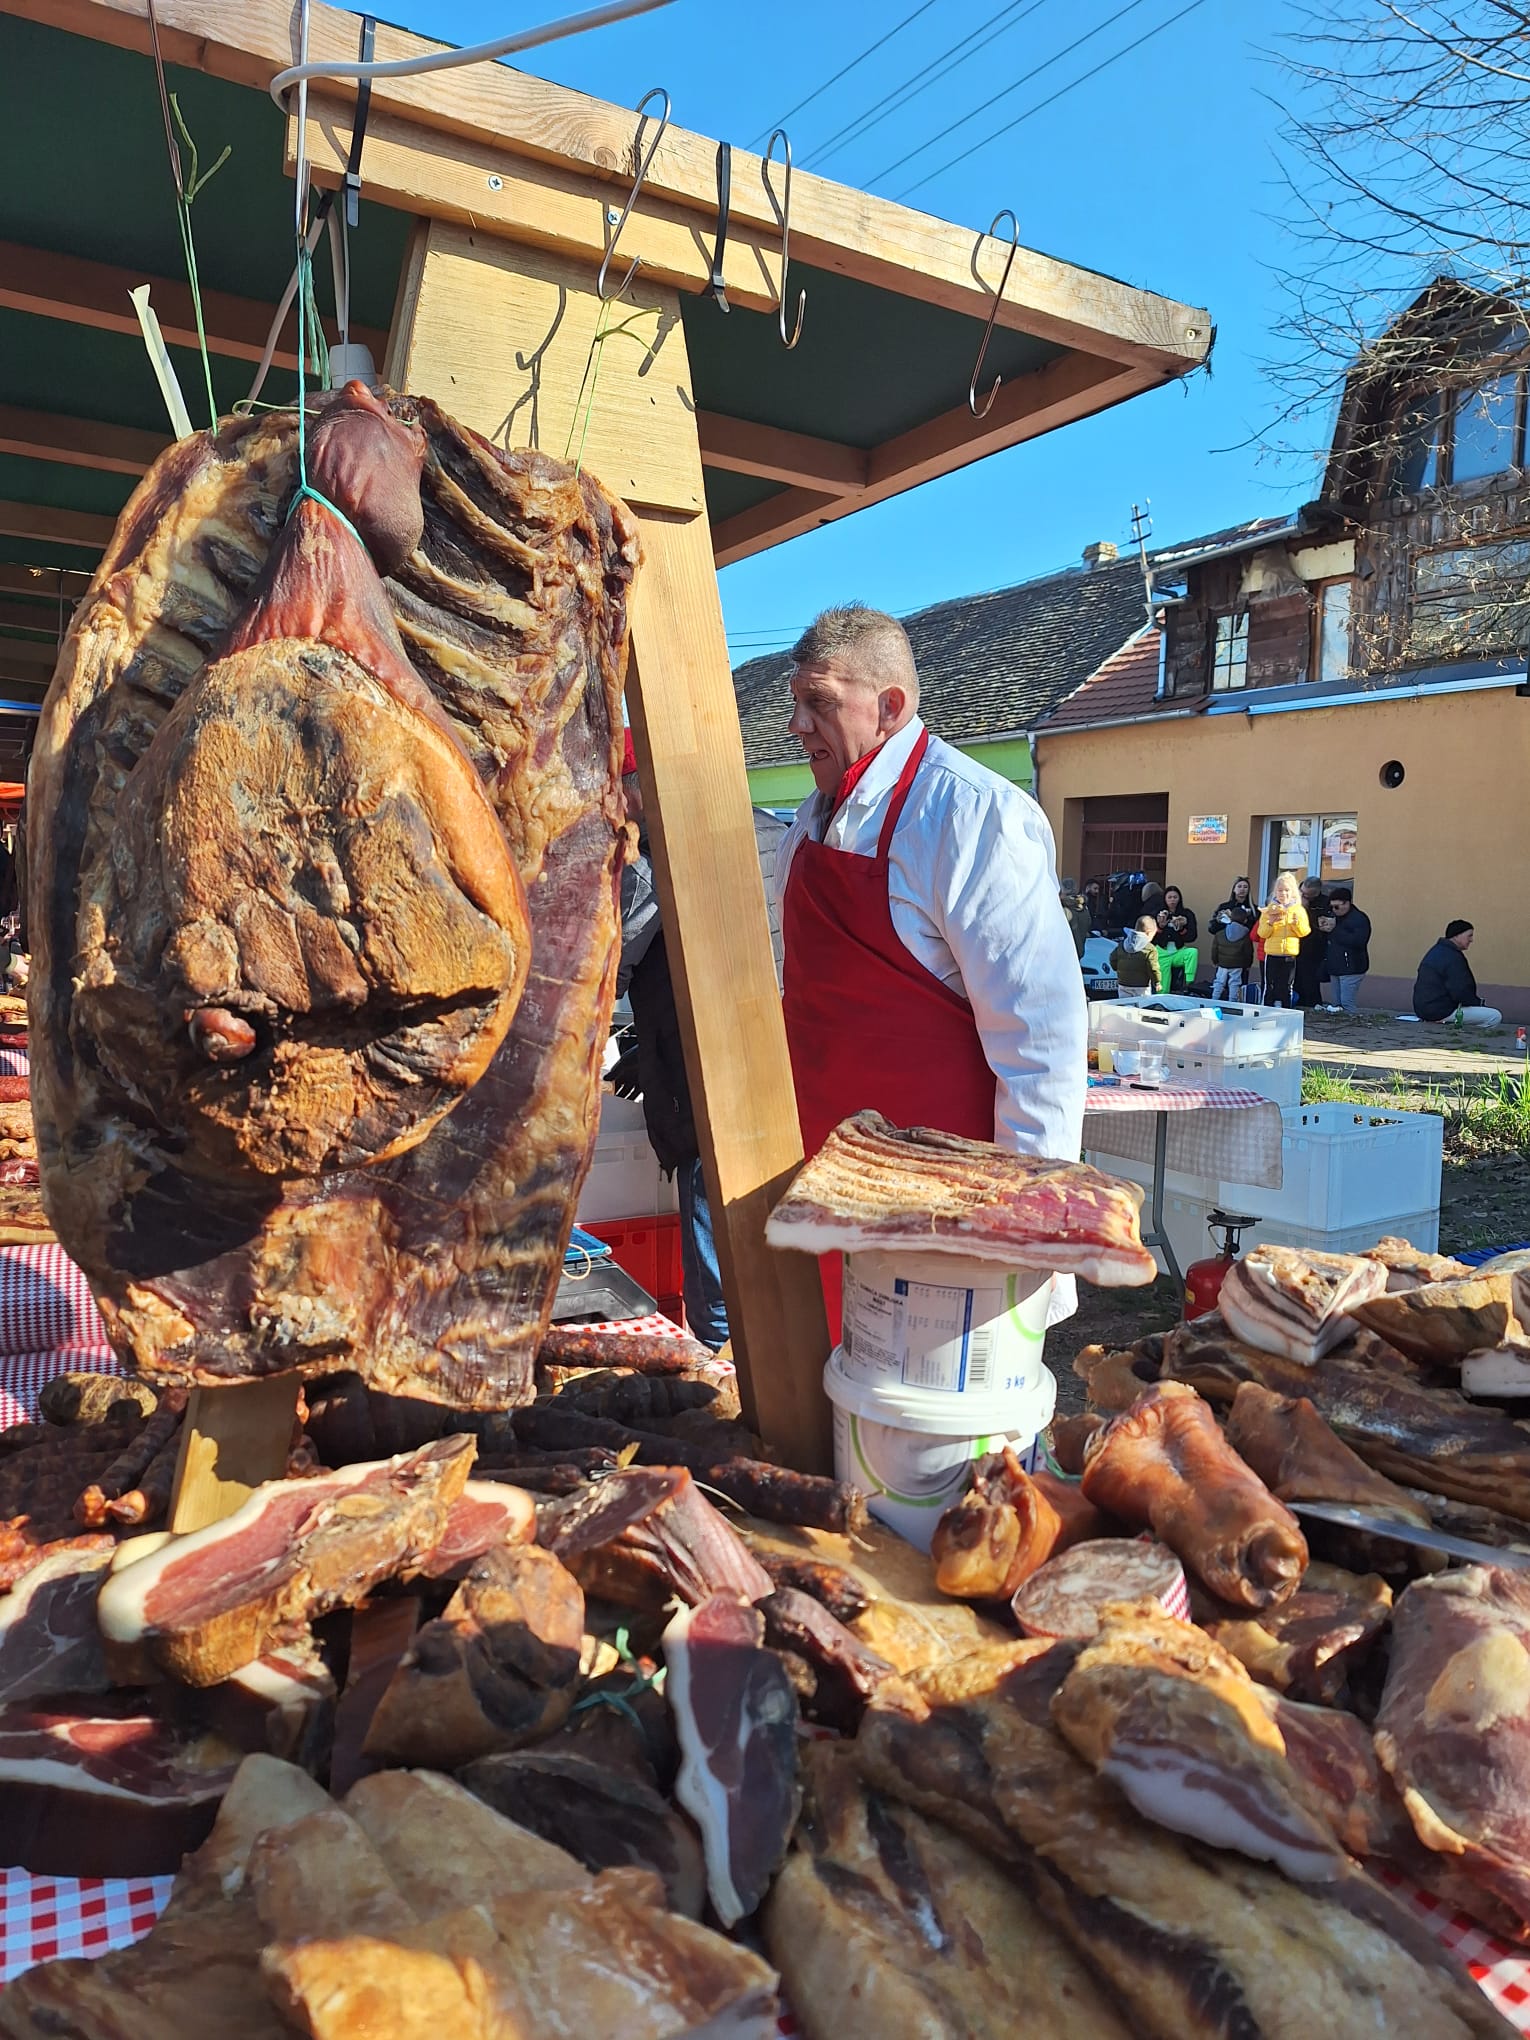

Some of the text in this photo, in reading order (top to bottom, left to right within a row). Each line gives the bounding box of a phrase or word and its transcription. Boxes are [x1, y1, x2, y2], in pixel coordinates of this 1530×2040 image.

[1096, 980, 1104, 988] KG
[1005, 1375, 1025, 1390] 3 kg
